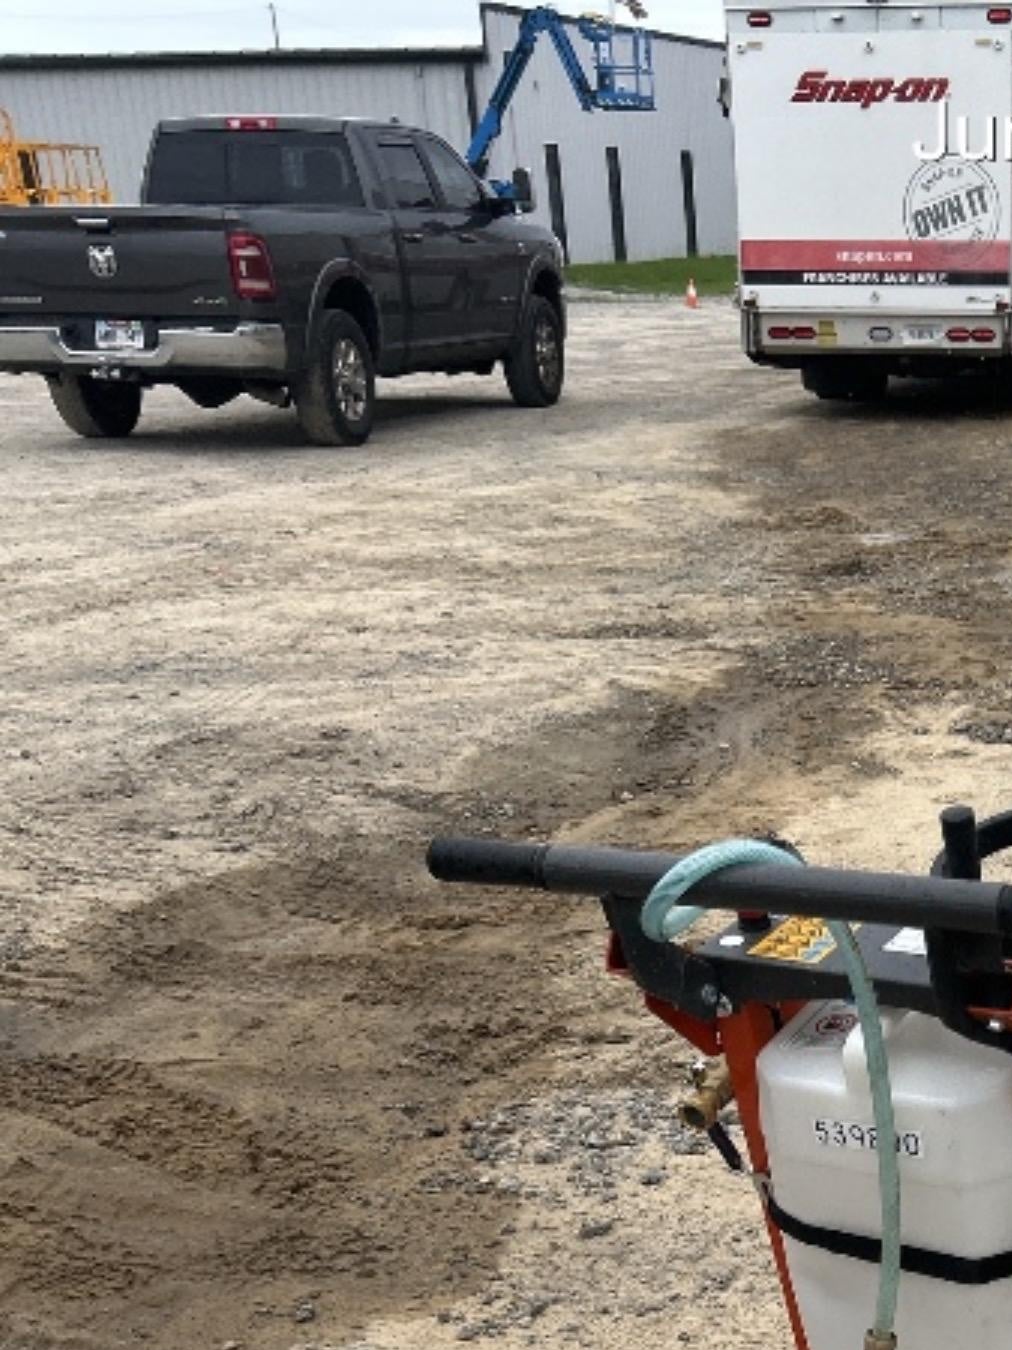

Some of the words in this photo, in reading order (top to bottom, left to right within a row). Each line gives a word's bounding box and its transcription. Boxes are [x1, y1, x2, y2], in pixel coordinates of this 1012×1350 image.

[790, 71, 948, 108] Snap-on
[913, 195, 967, 238] OWN
[966, 185, 988, 216] IT
[815, 1120, 920, 1156] 53980
